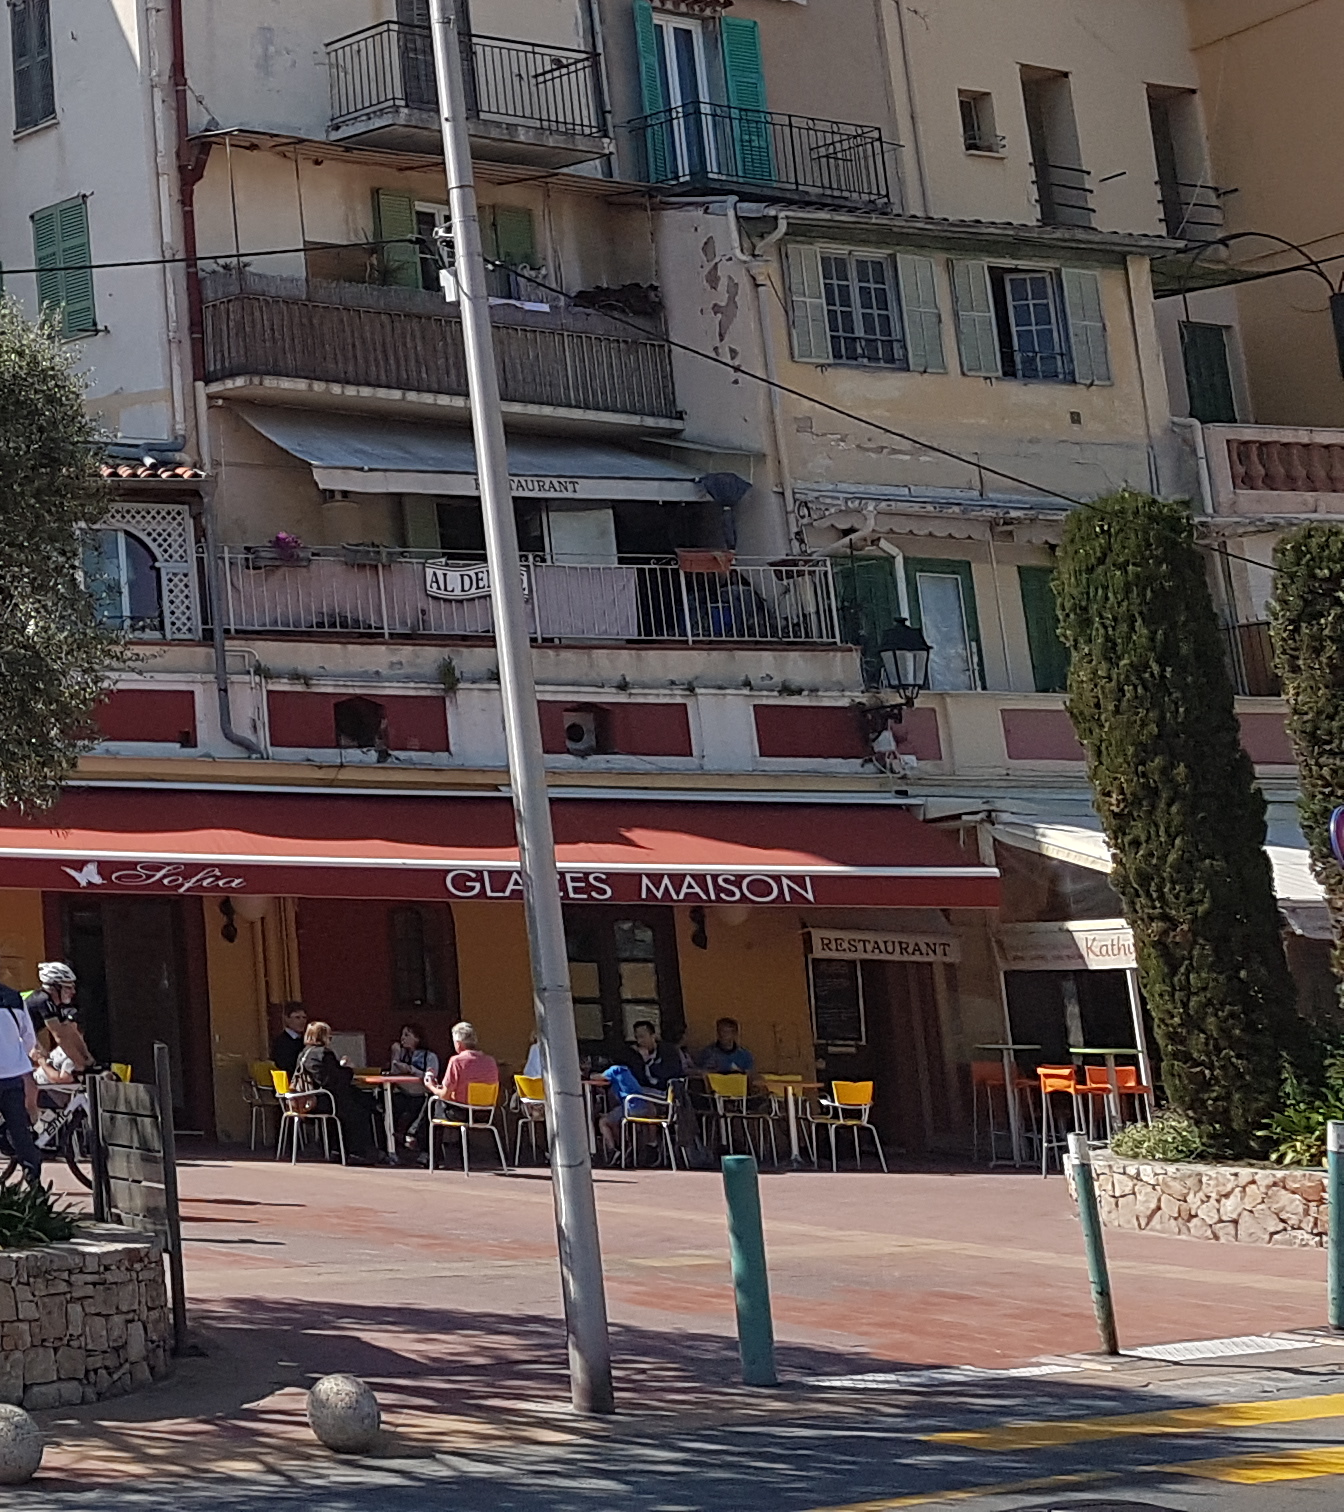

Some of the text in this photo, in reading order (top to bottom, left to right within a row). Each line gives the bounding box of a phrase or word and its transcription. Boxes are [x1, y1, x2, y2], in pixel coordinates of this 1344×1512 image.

[474, 478, 579, 493] RTAURANT
[429, 570, 455, 593] AL
[111, 862, 248, 893] Sofia
[445, 869, 815, 903] GLAES MAISON
[820, 937, 951, 957] RESTAURANT
